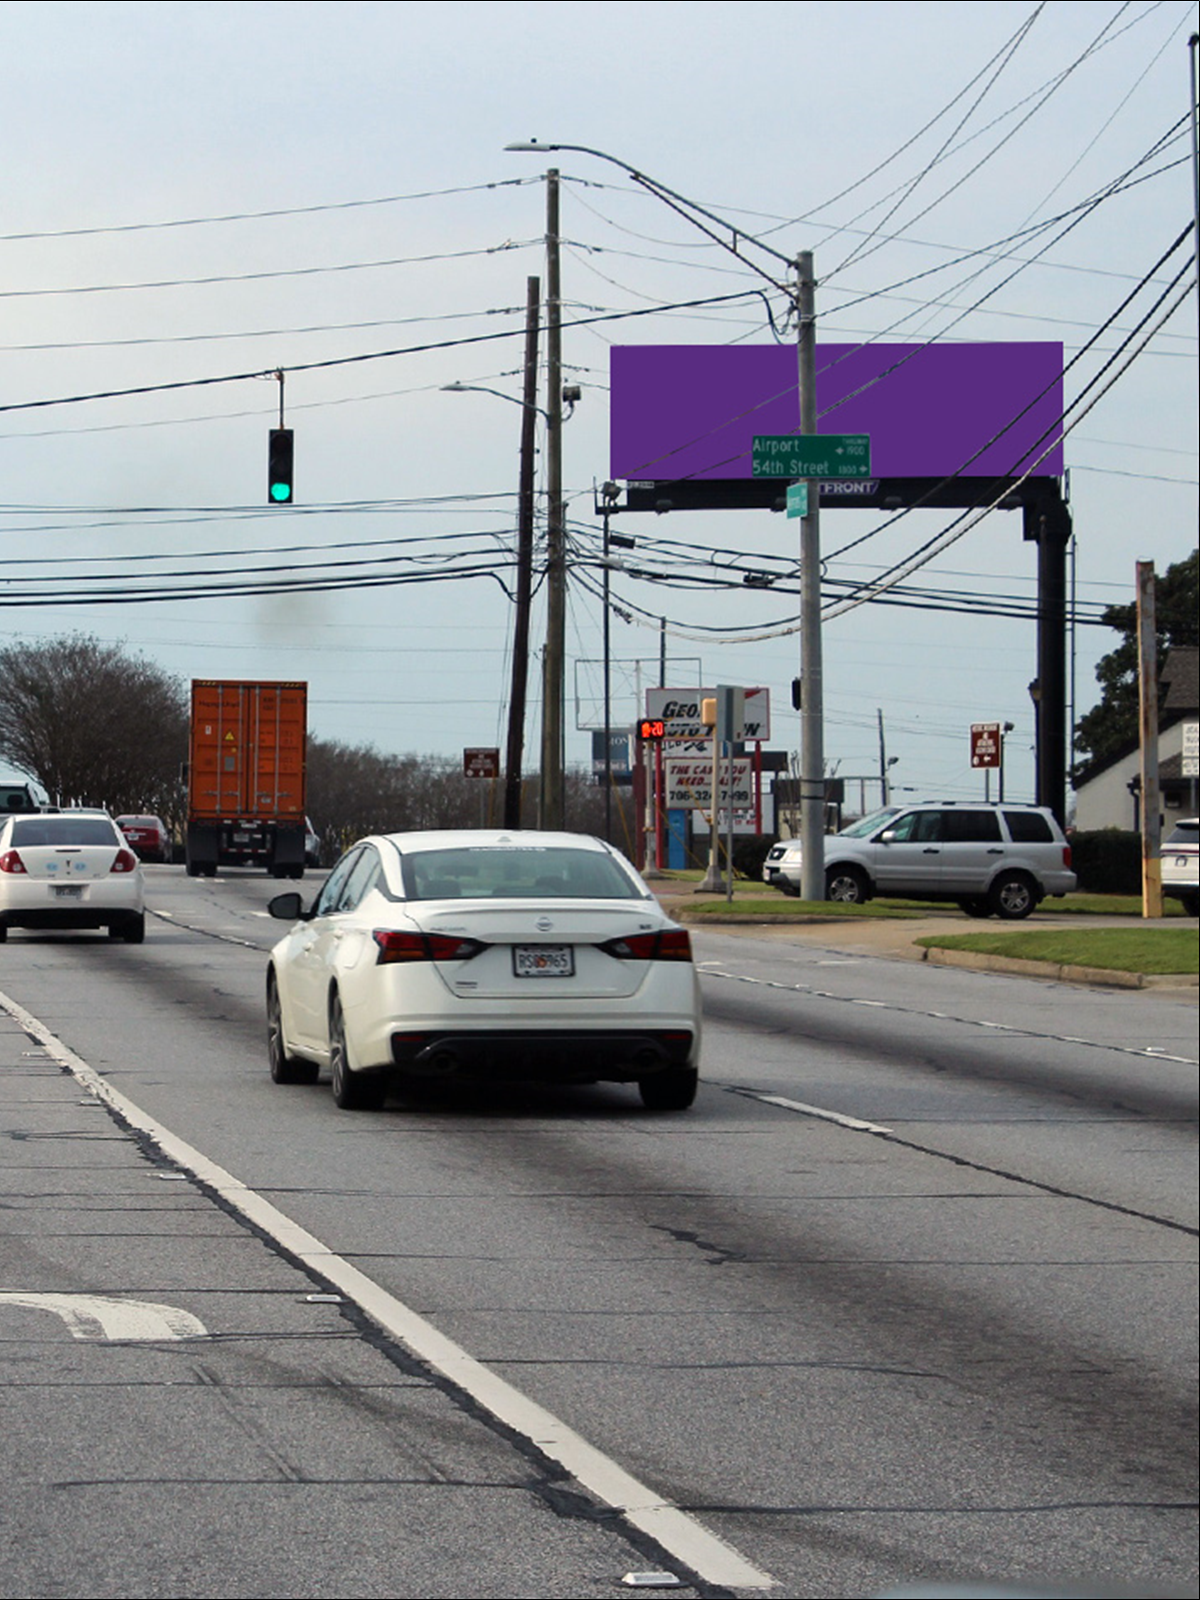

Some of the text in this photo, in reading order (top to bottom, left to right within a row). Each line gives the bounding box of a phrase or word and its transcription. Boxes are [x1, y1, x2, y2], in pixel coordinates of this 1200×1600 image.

[753, 438, 799, 455] Airport
[846, 446, 865, 455] 1900
[753, 460, 783, 474] 54th
[790, 459, 829, 474] Street
[670, 765, 689, 776] THE
